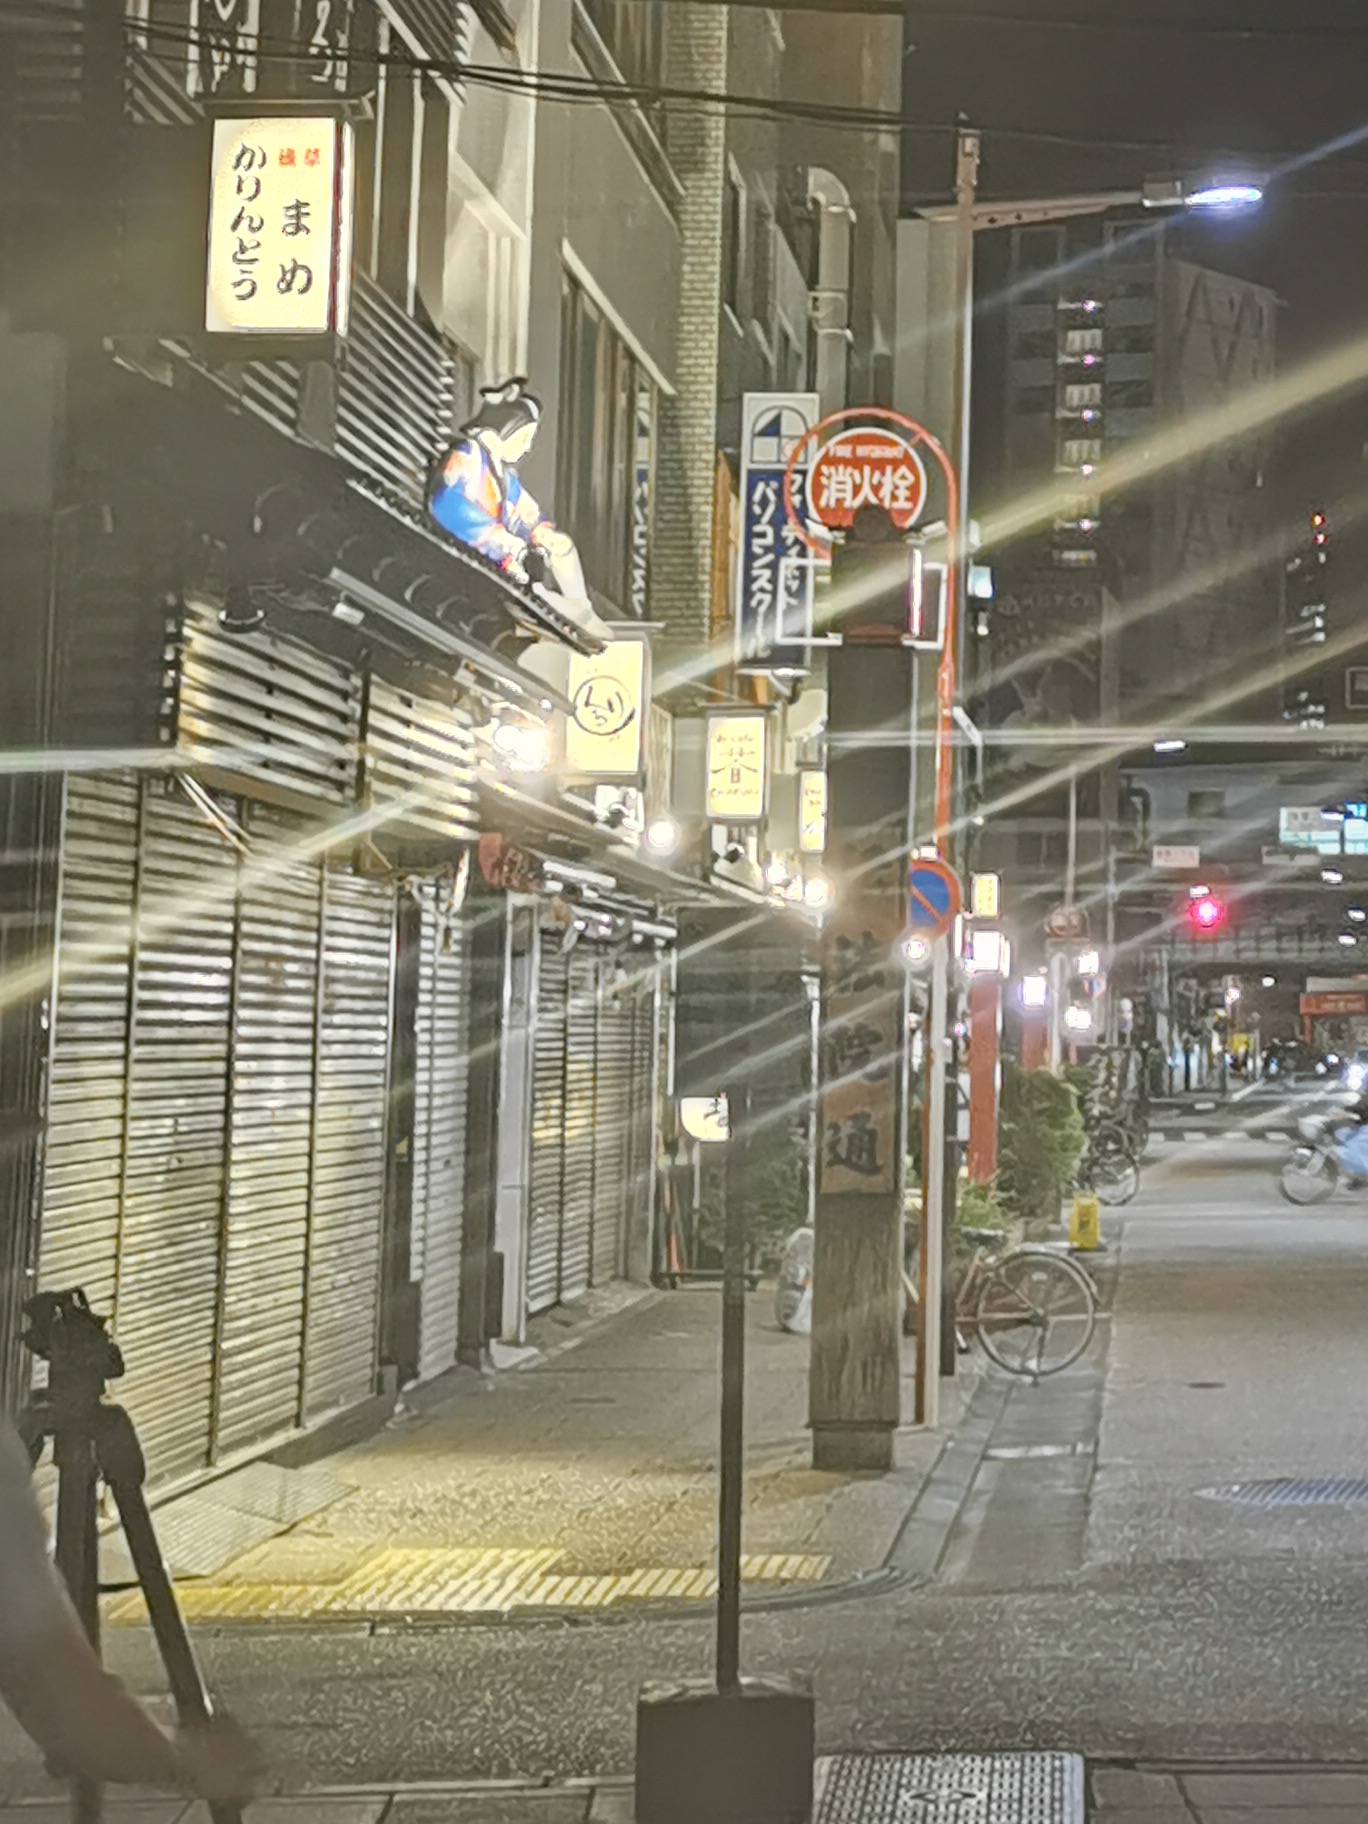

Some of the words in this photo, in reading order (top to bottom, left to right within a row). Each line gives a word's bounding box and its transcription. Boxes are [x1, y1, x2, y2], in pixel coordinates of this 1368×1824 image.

[230, 142, 267, 301] かりんとう
[276, 198, 314, 295] まめ
[818, 463, 916, 510] 消火栓
[747, 480, 780, 659] パソコンスクール
